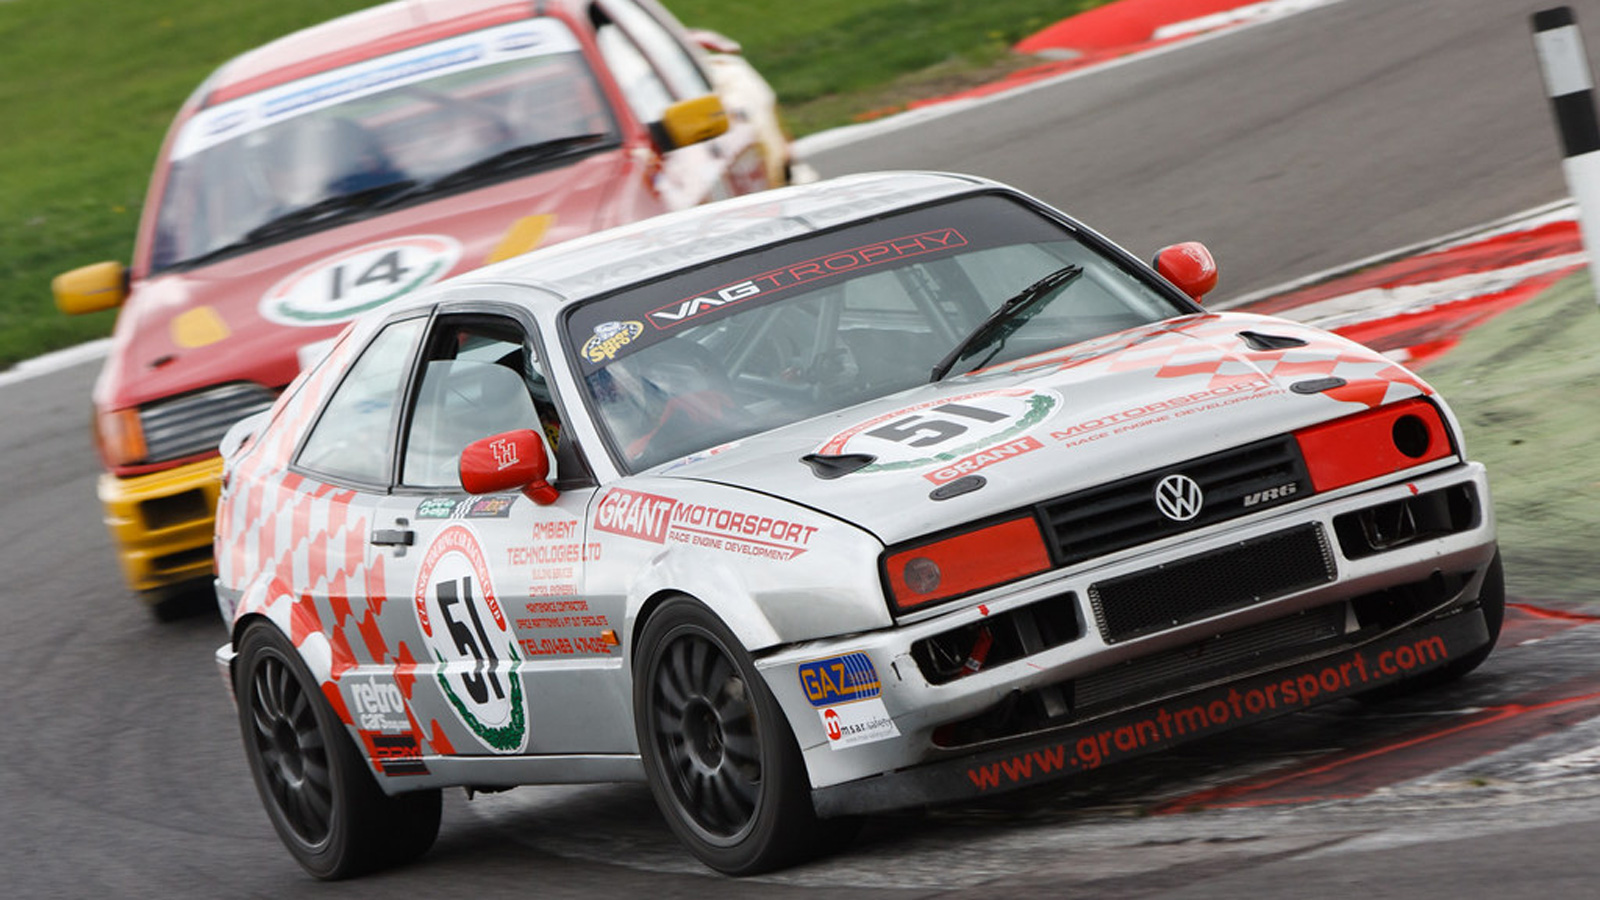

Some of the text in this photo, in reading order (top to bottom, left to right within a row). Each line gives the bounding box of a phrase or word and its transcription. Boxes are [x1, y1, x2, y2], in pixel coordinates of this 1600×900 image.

[331, 250, 411, 300] 14
[652, 233, 951, 320] VAG TROPHY
[865, 403, 1011, 447] 51
[1065, 431, 1109, 449] RACE
[1113, 414, 1170, 434] ENGINE
[934, 439, 1037, 481] GRANT
[532, 520, 577, 541] AMBIENT
[600, 491, 819, 545] GRANT MOTORSPORT
[507, 542, 602, 565] TECHNOLOGIES LTD
[669, 531, 790, 561] RACE ENGINE DEVELOPMENT
[436, 576, 506, 704] 51
[350, 675, 405, 713] retro
[801, 663, 860, 701] GAZ
[968, 633, 1449, 791] www.grantmotorsport.com
